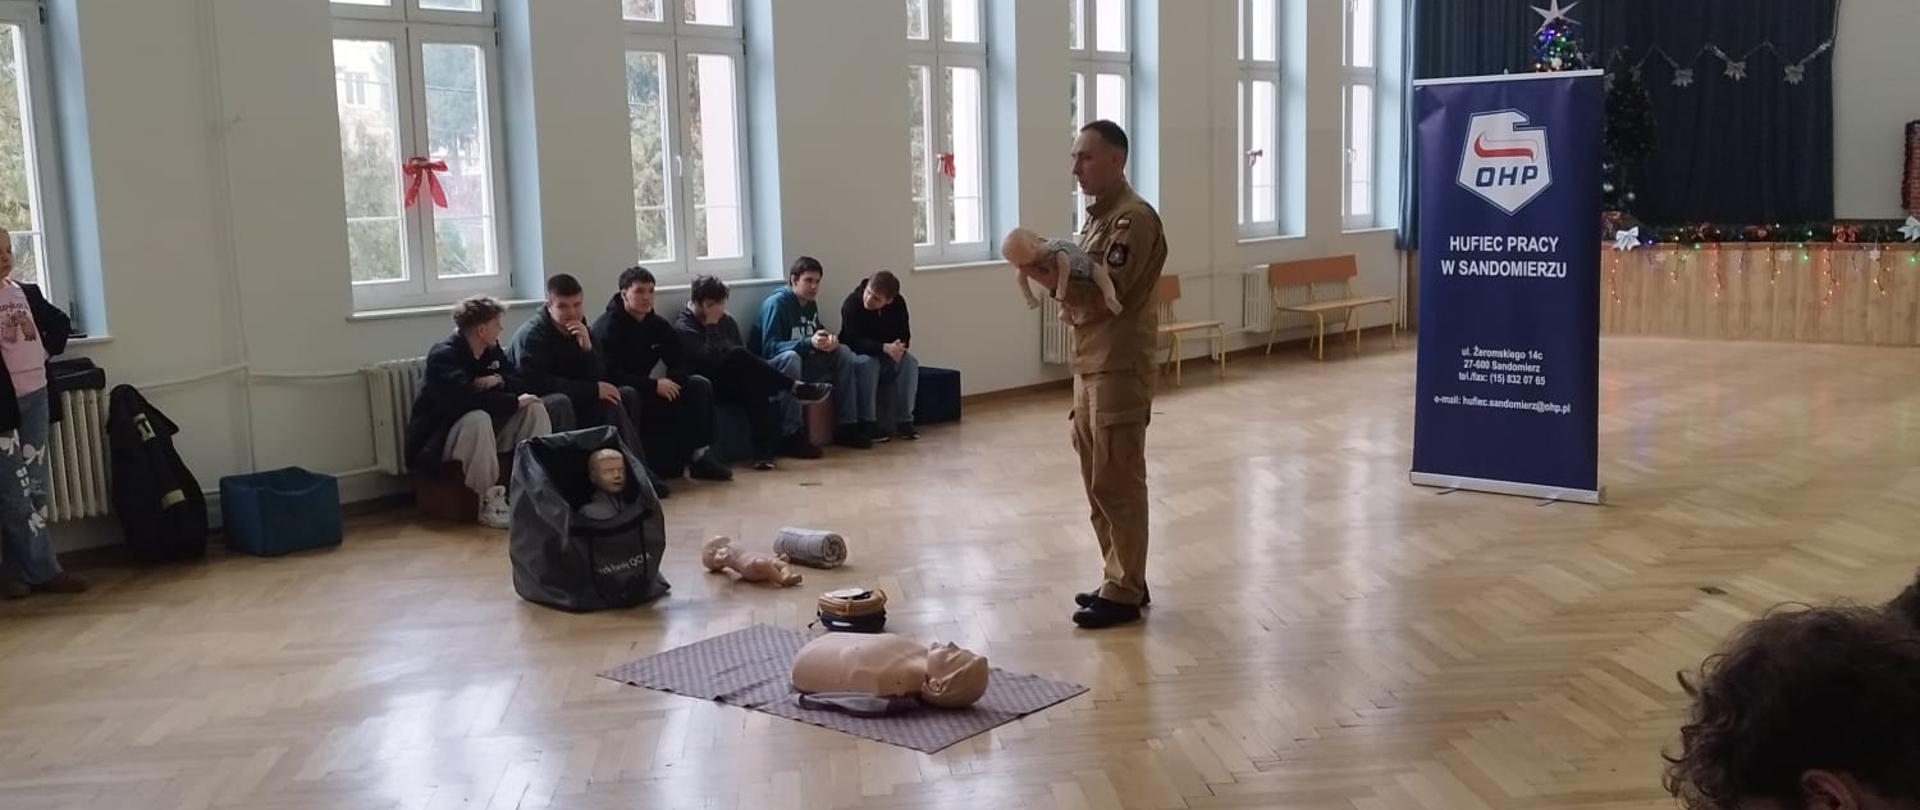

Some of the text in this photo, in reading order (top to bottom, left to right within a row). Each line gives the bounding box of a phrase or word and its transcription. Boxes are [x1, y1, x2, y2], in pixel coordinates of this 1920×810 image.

[1475, 165, 1538, 187] OHP
[1450, 236, 1559, 253] HUFIEC PRACY
[1441, 260, 1567, 278] W SANDOMIERZU
[1461, 345, 1543, 361] ul. Żeromskiego 14c
[1464, 359, 1541, 373] 27-600 Sandomierz
[1489, 373, 1505, 384] (15)
[1507, 373, 1522, 384] 832
[1523, 375, 1533, 385] 07
[1434, 395, 1571, 414] e-mail: hufiec.sandomierz@ohp.pl
